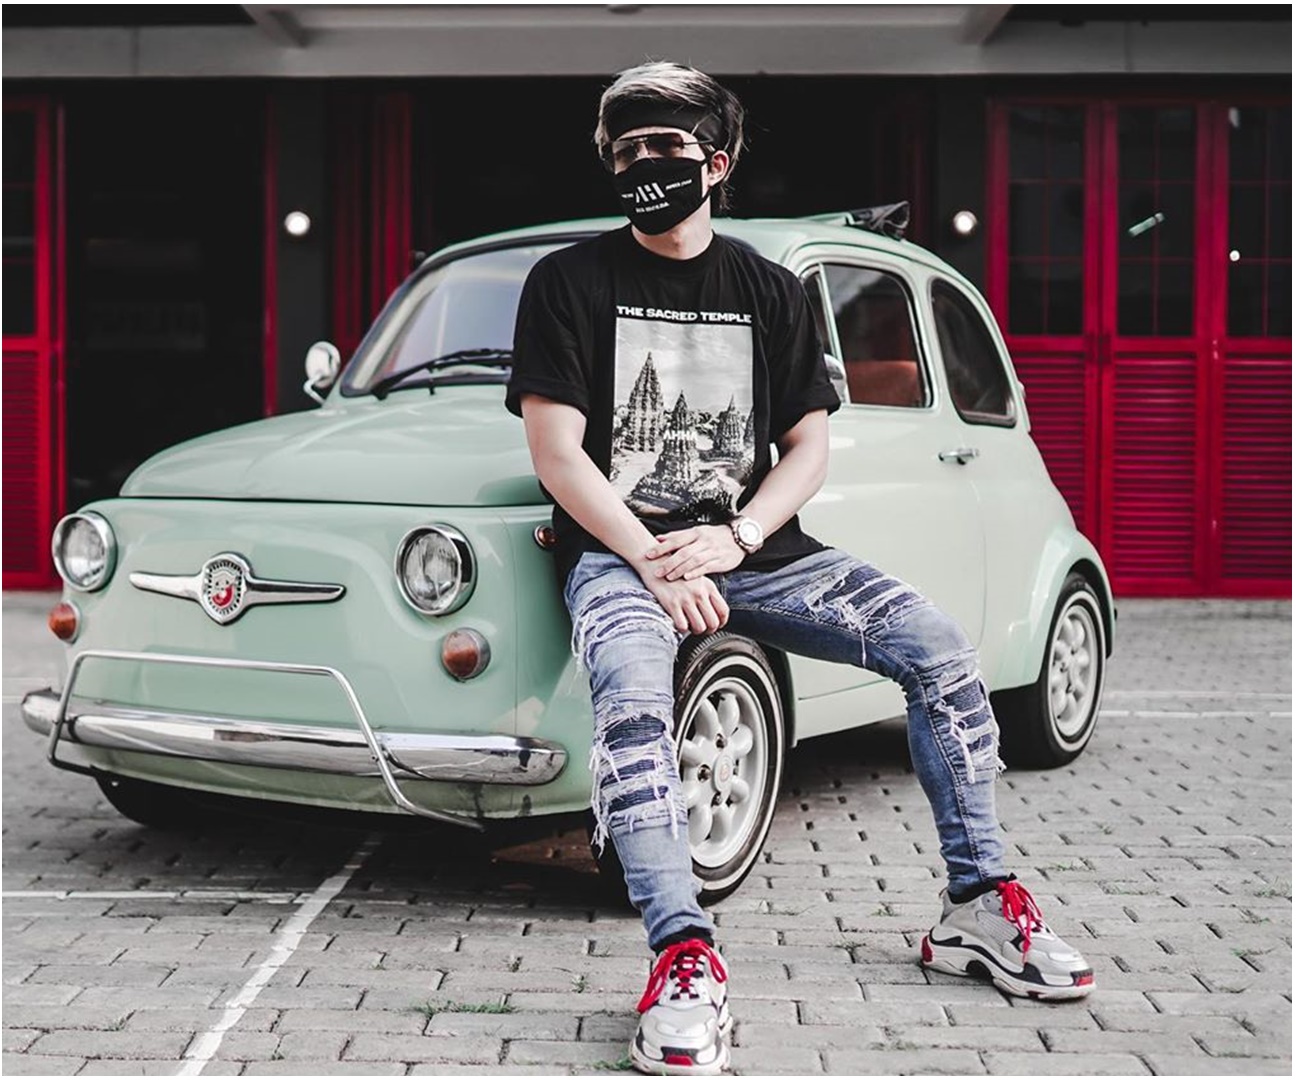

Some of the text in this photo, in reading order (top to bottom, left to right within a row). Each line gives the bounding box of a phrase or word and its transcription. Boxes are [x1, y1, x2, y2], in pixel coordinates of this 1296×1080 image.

[616, 305, 752, 323] THE SACRED TEMPLE
